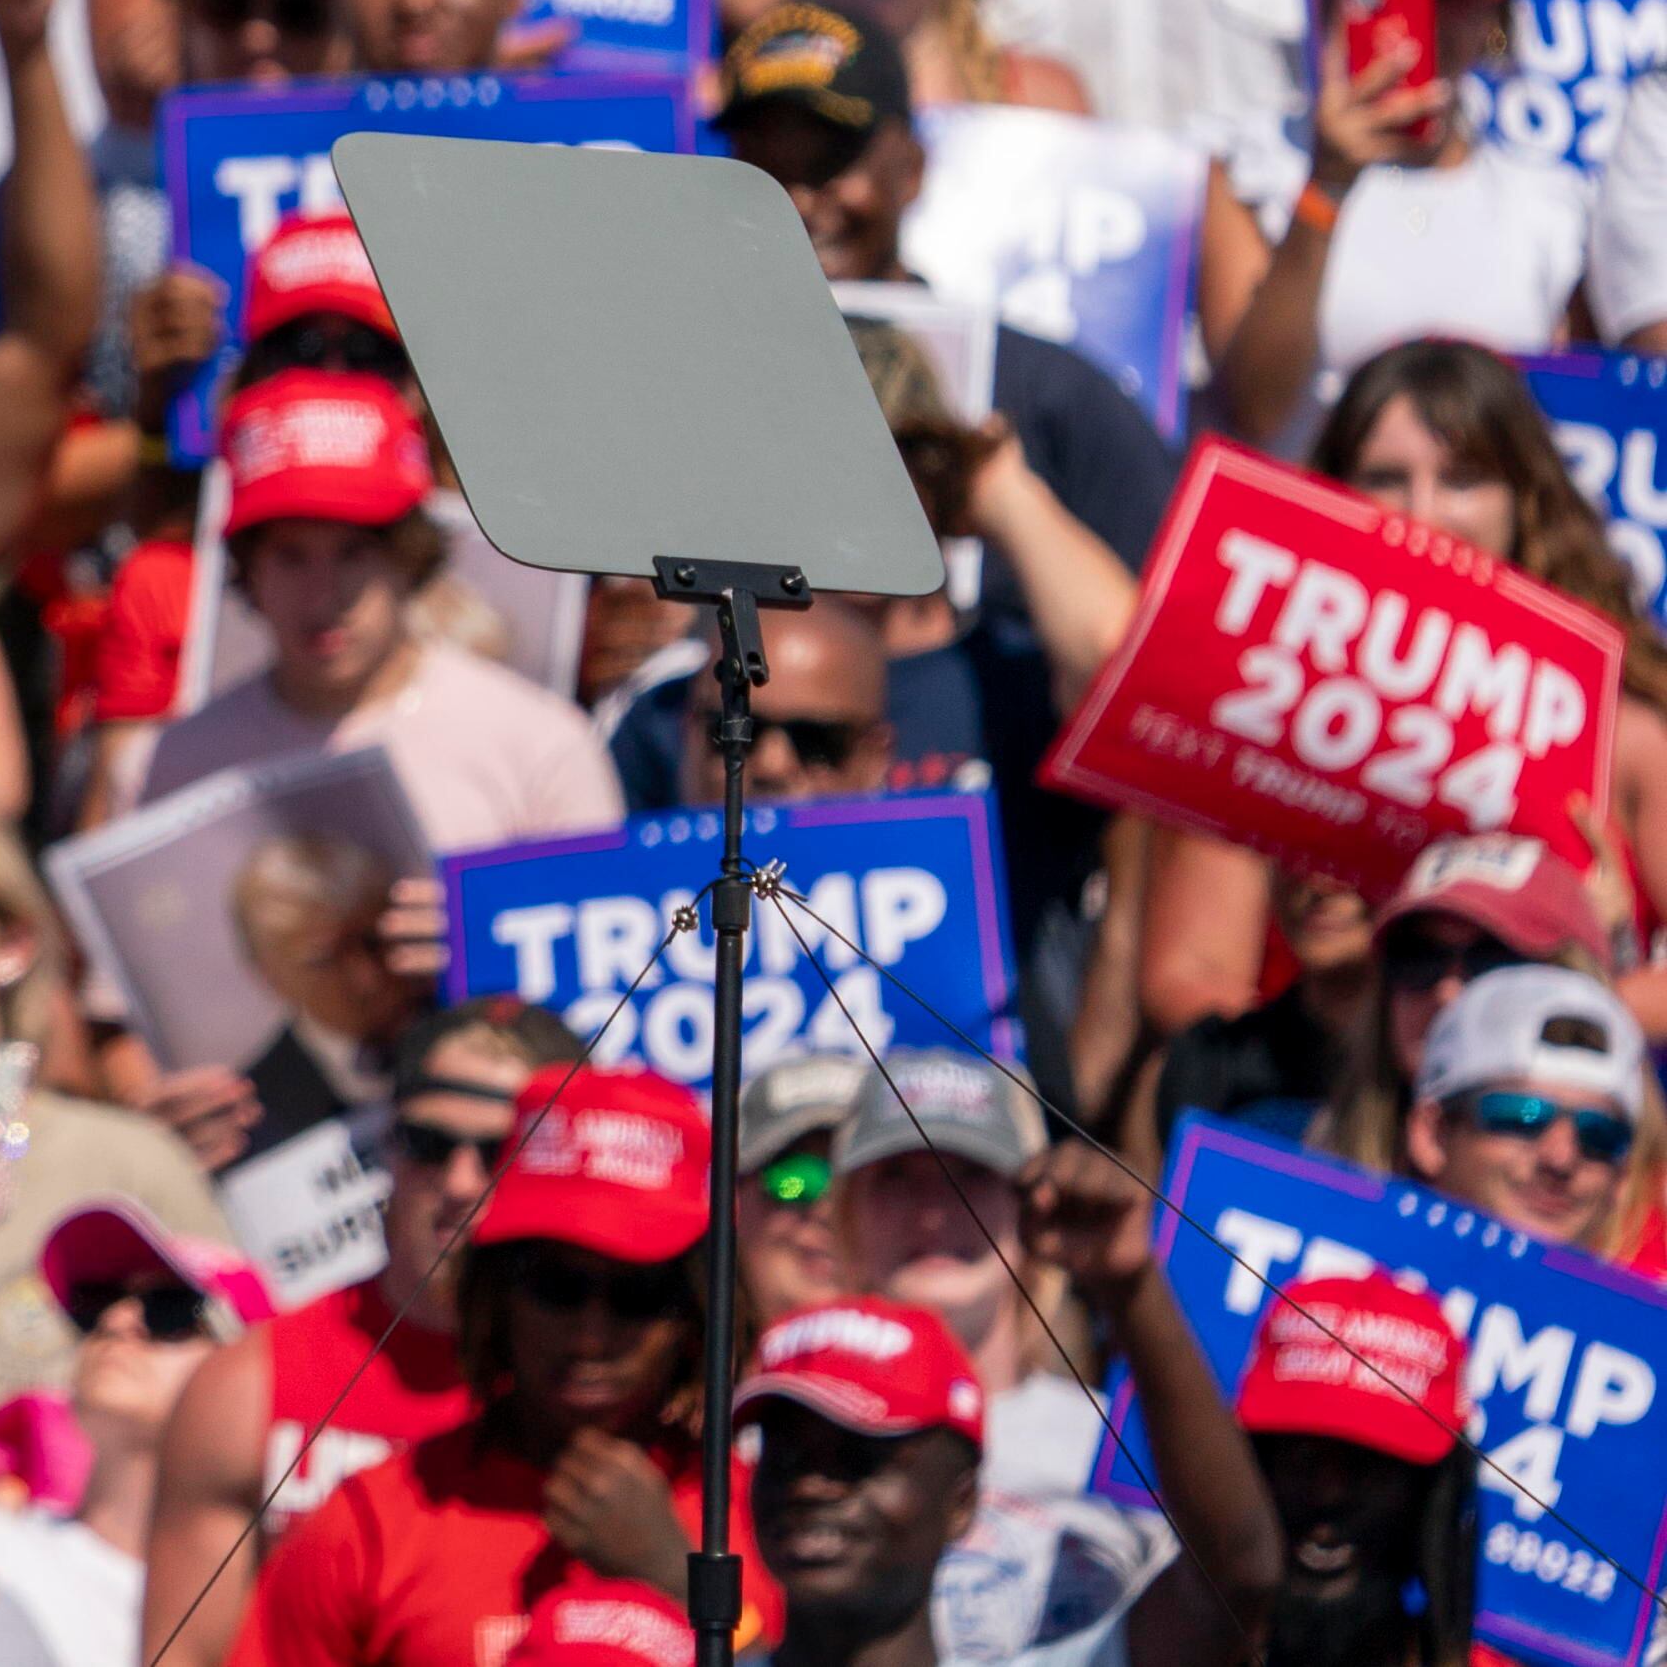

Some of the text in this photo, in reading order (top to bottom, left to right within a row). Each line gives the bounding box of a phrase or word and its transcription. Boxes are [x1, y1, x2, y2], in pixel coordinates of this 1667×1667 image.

[1210, 644, 1525, 832] 2024
[1213, 527, 1588, 760] TRUMP
[491, 866, 948, 1004] TRUMP
[1214, 1207, 1657, 1440] TMP
